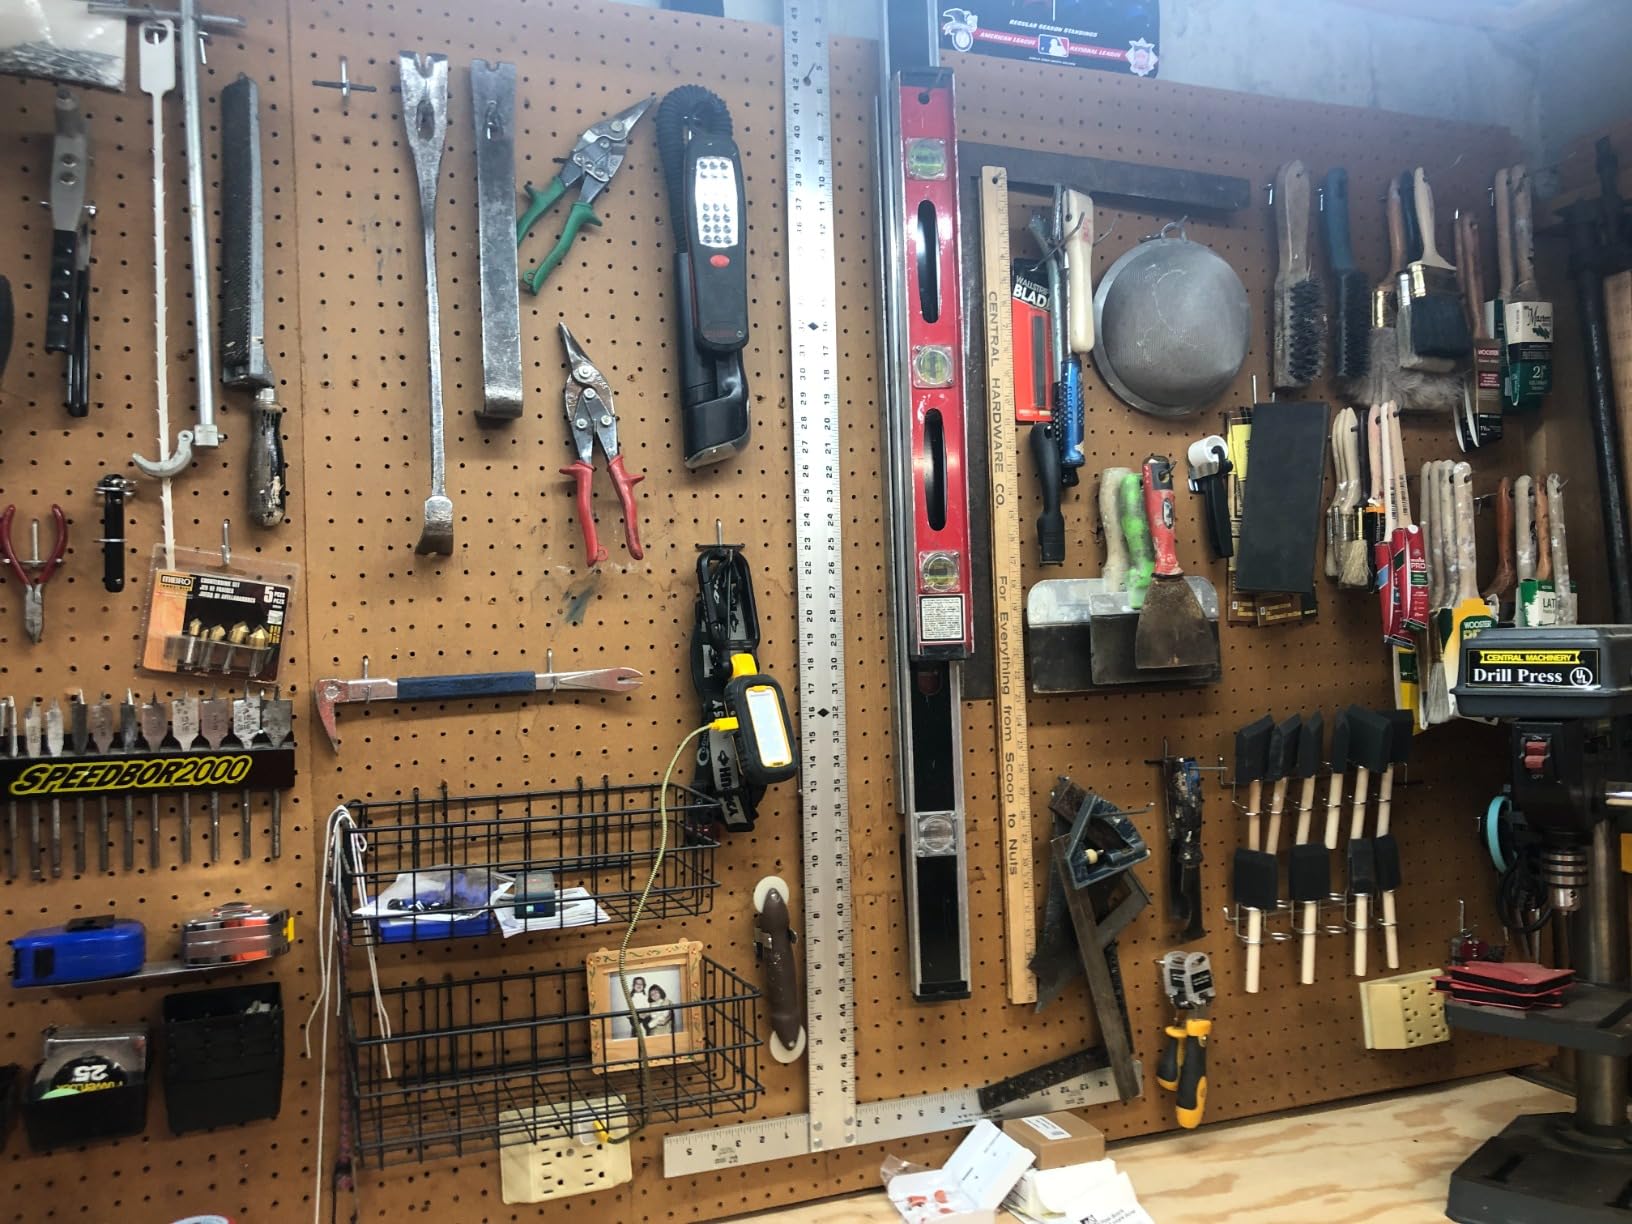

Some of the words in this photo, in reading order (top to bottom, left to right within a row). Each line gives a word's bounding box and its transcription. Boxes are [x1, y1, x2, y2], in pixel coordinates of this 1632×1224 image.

[1009, 19, 1037, 30] REGULAR
[1038, 23, 1063, 33] SEASON
[1063, 26, 1098, 38] STANDINGS
[792, 31, 798, 43] 44
[979, 32, 1012, 42] AMERICAN
[1013, 36, 1036, 46] LEAGUE
[1069, 46, 1098, 55] NATIONAL
[1098, 49, 1121, 58] LEAGUE
[792, 54, 798, 67] 43
[792, 78, 799, 90] 42
[793, 103, 799, 114] 41
[794, 125, 800, 138] 40
[794, 149, 801, 162] 39
[795, 173, 802, 186] 38
[819, 176, 825, 187] 10
[795, 198, 801, 210] 37
[819, 202, 825, 211] 11
[1013, 283, 1050, 309] BLAD
[989, 291, 1000, 368] CENTRAL
[823, 346, 828, 356] 17
[800, 368, 806, 380] 30
[824, 370, 829, 380] 18
[800, 392, 806, 405] 29
[824, 394, 830, 405] 19
[801, 416, 807, 429] 28
[824, 418, 830, 430] 20
[992, 378, 1004, 472] HARDWARE
[802, 440, 808, 453] 27
[825, 443, 831, 454] 21
[803, 465, 809, 477] 26
[826, 466, 832, 478] 22
[803, 489, 809, 502] 25
[827, 490, 833, 502] 23
[995, 483, 1005, 509] CO.
[804, 513, 810, 526] 24
[827, 514, 834, 526] 24
[804, 538, 811, 550] 23
[828, 538, 834, 550] 25
[805, 561, 811, 574] 22
[828, 562, 835, 574] 26
[264, 586, 274, 603] 5
[806, 587, 812, 598] 21
[829, 586, 835, 598] 27
[998, 576, 1008, 601] For
[1542, 598, 1556, 609] LAT
[806, 610, 813, 622] 20
[830, 610, 836, 622] 28
[1463, 620, 1492, 629] WOOSTER
[807, 633, 813, 646] 19
[830, 634, 837, 646] 29
[998, 612, 1012, 695] Everything
[1487, 654, 1523, 662] CENTRAL
[1526, 654, 1572, 662] MACHINERY
[807, 658, 814, 670] 18
[831, 658, 837, 670] 30
[1473, 668, 1512, 682] Drill
[1517, 669, 1563, 683] Press
[808, 683, 814, 694] 17
[832, 683, 838, 694] 31
[809, 707, 815, 719] 16
[832, 706, 838, 719] 32
[1003, 705, 1012, 742] from
[809, 732, 815, 743] 15
[833, 731, 839, 743] 33
[810, 756, 816, 768] 14
[833, 755, 840, 767] 34
[11, 756, 249, 793] SPEEDBOR2000
[1004, 752, 1015, 803] Scoop
[810, 781, 817, 792] 13
[834, 779, 841, 792] 35
[811, 805, 817, 817] 12
[834, 804, 841, 816] 36
[1008, 813, 1016, 828] to
[811, 832, 818, 842] 11
[835, 829, 842, 841] 37
[812, 855, 818, 867] 10
[836, 854, 842, 866] 38
[1009, 839, 1018, 875] Nuts
[836, 878, 843, 891] 39
[837, 903, 843, 916] 40
[837, 930, 844, 941] 41
[838, 953, 845, 967] 42
[839, 978, 846, 992] 43
[840, 1004, 847, 1017] 44
[840, 1028, 847, 1042] 45
[736, 1140, 741, 1148] 3
